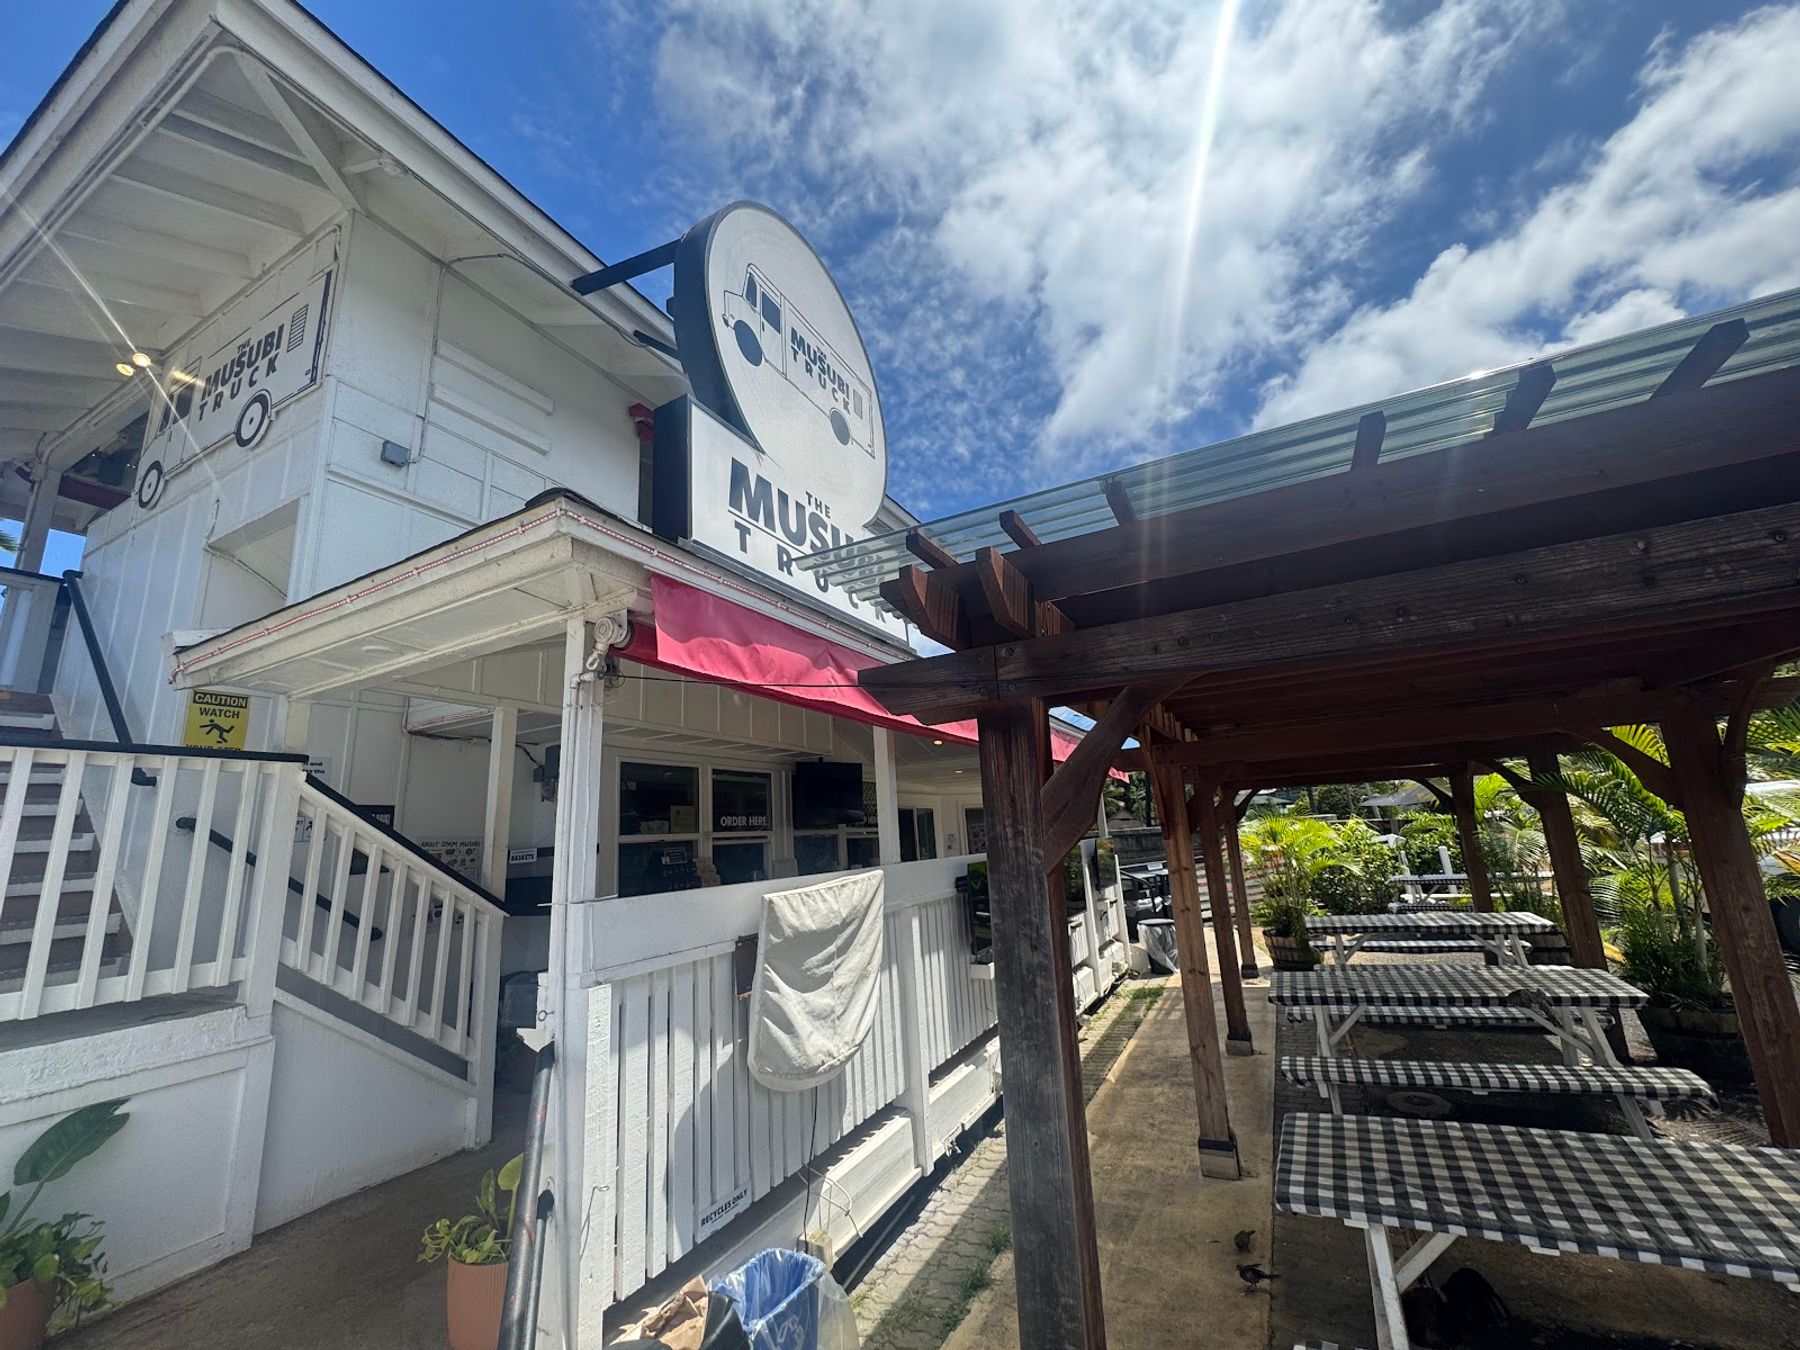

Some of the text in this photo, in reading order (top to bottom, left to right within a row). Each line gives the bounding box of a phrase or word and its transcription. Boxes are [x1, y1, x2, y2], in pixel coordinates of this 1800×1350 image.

[199, 352, 279, 421] TRUCK
[201, 323, 285, 402] MUSUBI
[790, 326, 850, 401] MUSUBI
[790, 345, 851, 415] TRUCK
[729, 457, 866, 566] MUSU
[806, 491, 831, 519] THE
[194, 692, 247, 708] CAUTION
[199, 706, 240, 719] WATCH
[720, 815, 767, 827] ORDER HERE
[701, 1200, 732, 1227] RECYCLES
[732, 1188, 748, 1204] ONLY
